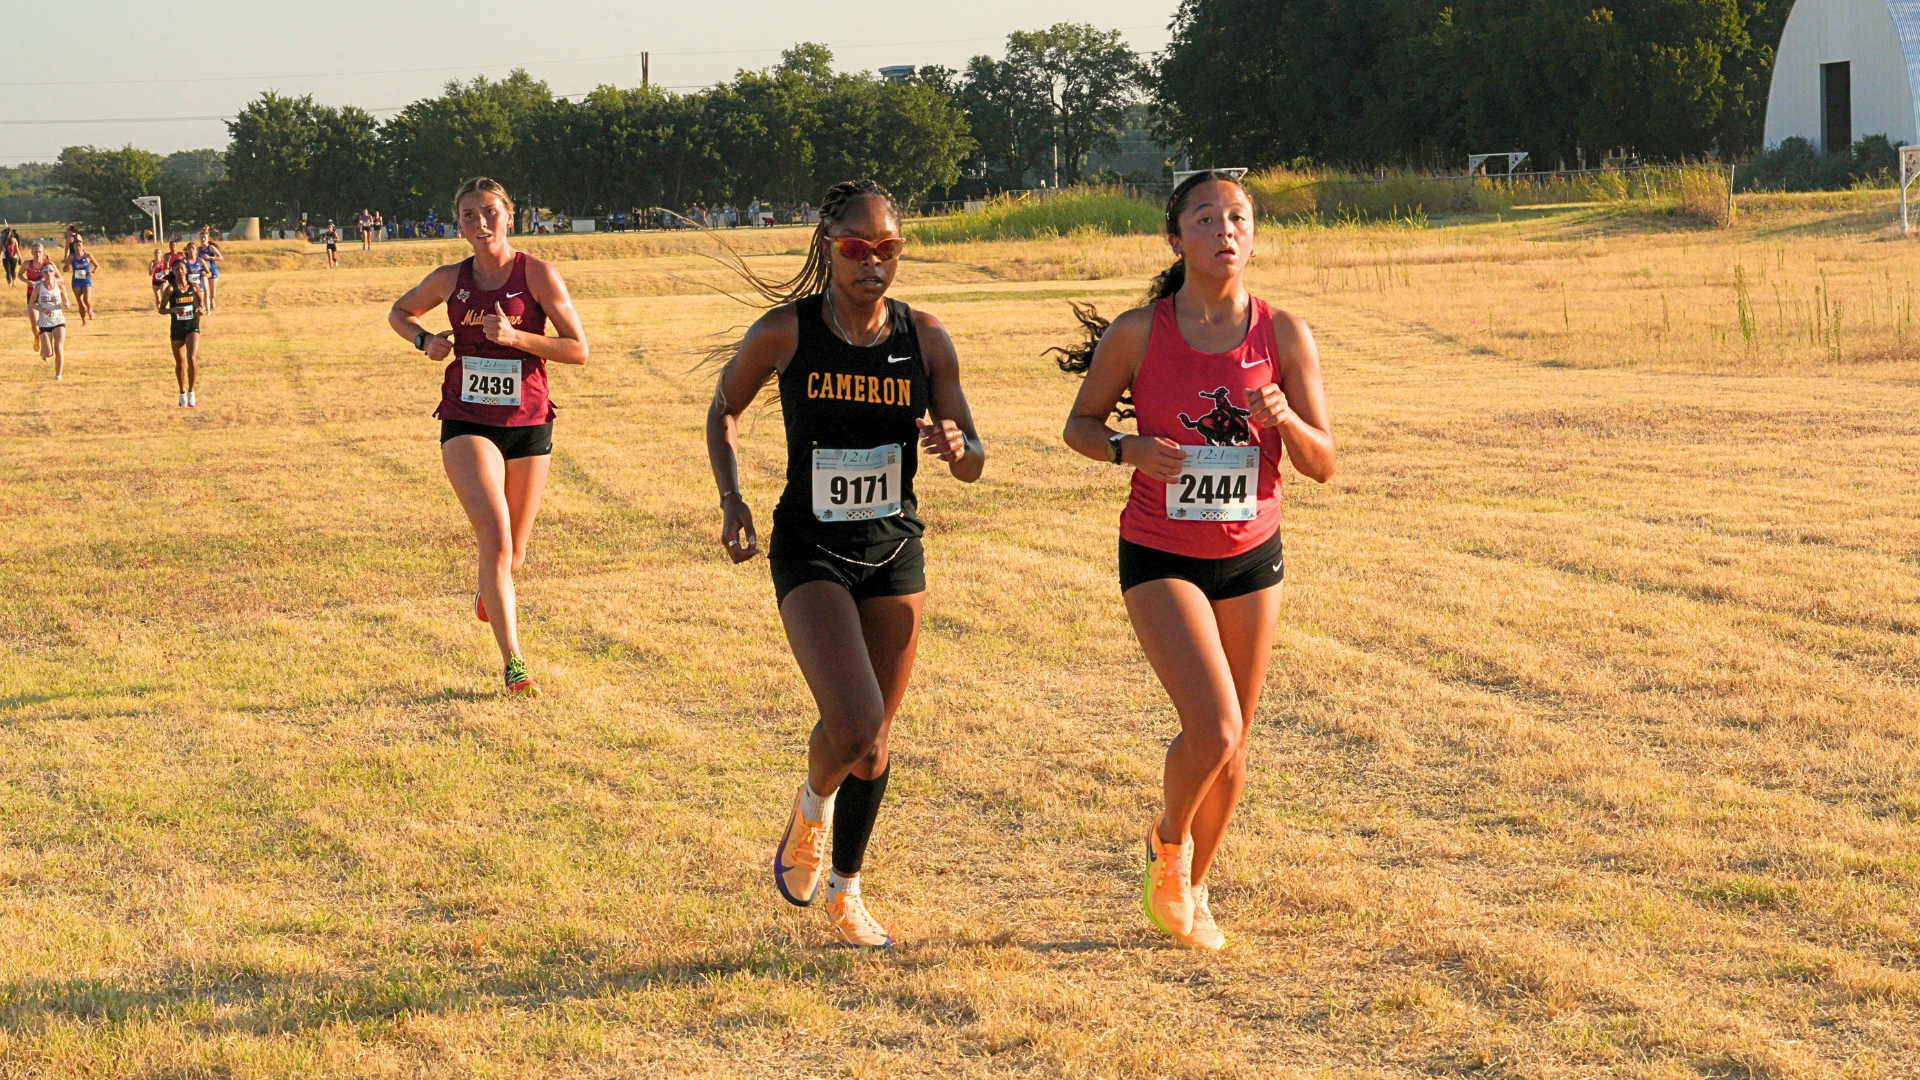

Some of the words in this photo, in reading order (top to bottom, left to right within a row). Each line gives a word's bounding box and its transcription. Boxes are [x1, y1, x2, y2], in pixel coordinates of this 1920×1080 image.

[469, 374, 514, 395] 2439
[807, 371, 911, 407] CAMERON
[842, 452, 871, 462] 12:1
[1196, 449, 1225, 460] 12:1
[830, 472, 888, 505] 9171
[1179, 474, 1247, 504] 2444
